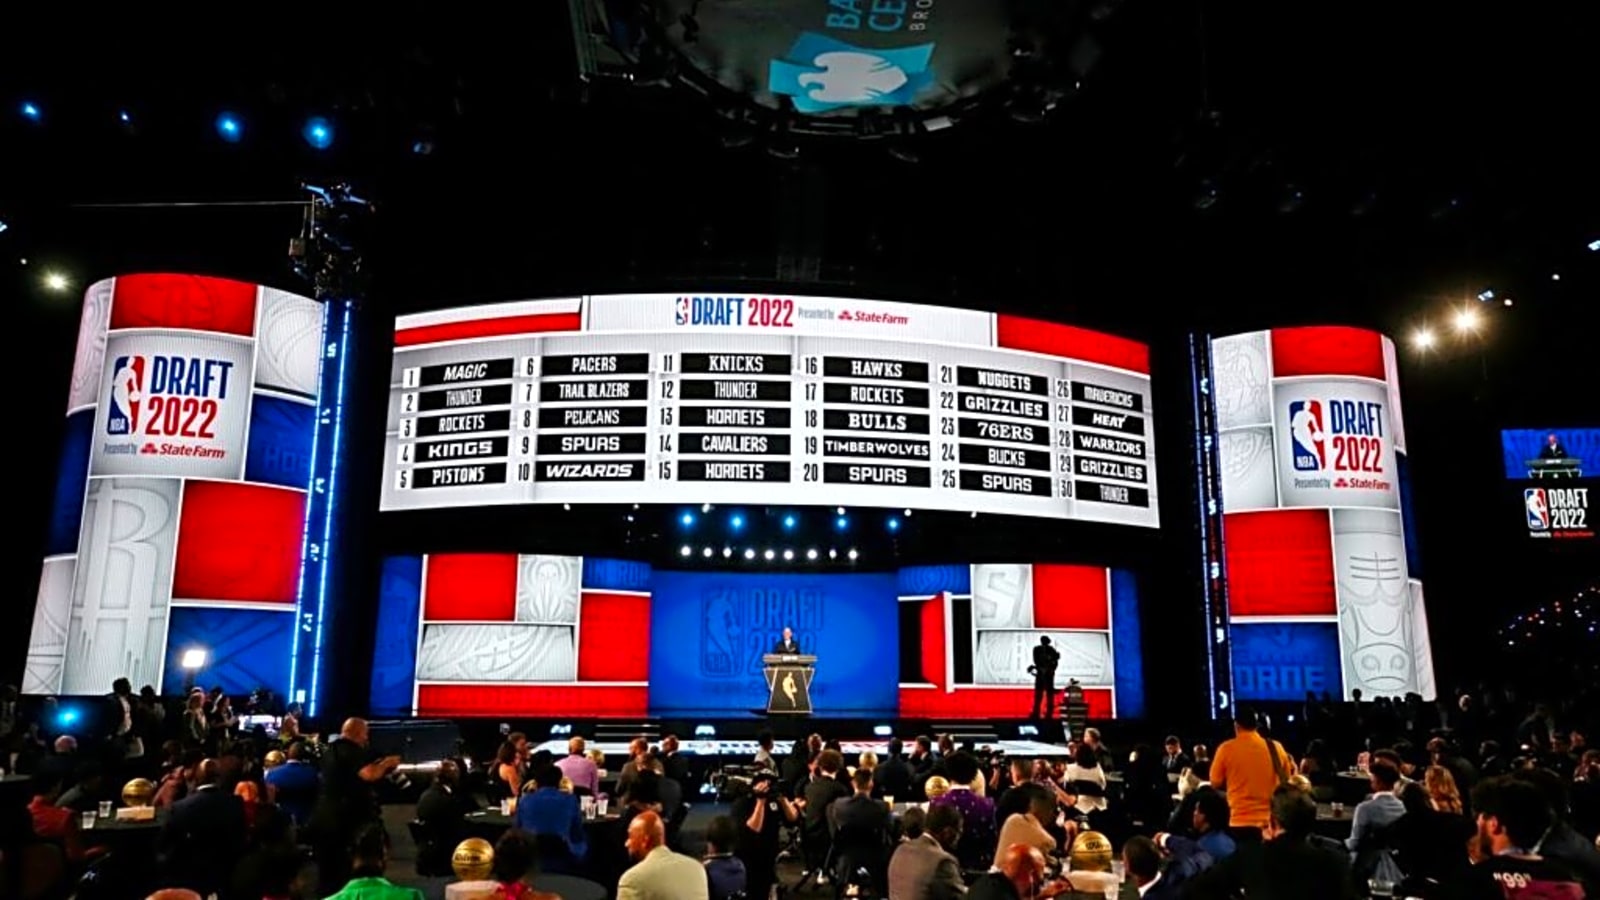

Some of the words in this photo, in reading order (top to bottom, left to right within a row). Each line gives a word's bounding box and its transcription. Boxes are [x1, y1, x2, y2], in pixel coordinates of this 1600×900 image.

[691, 297, 745, 326] DRAFT
[748, 298, 794, 328] 2022
[527, 359, 534, 375] 6
[572, 358, 616, 373] PACERS
[663, 355, 672, 371] 11
[709, 355, 763, 371] KNICKS
[805, 358, 817, 374] 16
[851, 360, 902, 378] HAWKS
[150, 355, 233, 399] DRAFT
[408, 370, 413, 386] 1
[443, 364, 488, 382] MAGIC
[940, 366, 952, 383] 21
[978, 371, 1031, 391] NUGGETS
[526, 384, 532, 400] 7
[559, 384, 585, 399] TRAIL
[587, 383, 629, 398] BLAZERS
[662, 381, 673, 398] 12
[714, 382, 758, 398] THUNDER
[805, 384, 816, 400] 17
[850, 387, 904, 404] ROCKETS
[1057, 380, 1069, 398] 26
[406, 394, 412, 411] 2
[446, 389, 482, 406] THUNDER
[940, 391, 954, 409] 22
[965, 395, 1043, 416] GRIZZLIES
[109, 418, 126, 432] NBA
[145, 396, 218, 439] 2022
[404, 420, 411, 436] 3
[439, 415, 485, 432] ROCKETS
[523, 410, 530, 427] 8
[564, 409, 620, 424] PELICANS
[661, 408, 672, 424] 13
[707, 409, 764, 425] HORNETS
[805, 411, 817, 427] 18
[848, 413, 907, 430] BULLS
[1058, 405, 1069, 422] 27
[1092, 413, 1127, 429] HEAT
[1329, 399, 1383, 438] DRAFT
[941, 418, 954, 435] 23
[978, 422, 1034, 441] 76ERS
[402, 446, 409, 462] 4
[428, 440, 493, 458] KINGS
[522, 437, 529, 454] 9
[561, 436, 620, 451] SPURS
[660, 435, 672, 451] 14
[702, 436, 768, 452] CAVALIERS
[805, 437, 817, 454] 19
[825, 440, 929, 456] TIMBERWOLVES
[1059, 429, 1071, 448] 28
[1080, 436, 1142, 456] WARRIORS
[942, 444, 955, 461] 24
[988, 449, 1025, 466] BUCKS
[1296, 455, 1315, 468] NBA
[1333, 436, 1383, 473] 2022
[400, 471, 407, 488] 5
[432, 466, 485, 484] PISTONS
[518, 463, 529, 480] 10
[546, 464, 633, 478] WIZARDS
[659, 462, 671, 479] 15
[705, 463, 764, 479] HORNETS
[804, 464, 818, 481] 20
[849, 467, 907, 483] SPURS
[1060, 455, 1071, 473] 29
[1080, 459, 1143, 480] GRIZZLIES
[942, 470, 955, 488] 25
[982, 475, 1032, 492] SPURS
[1061, 480, 1072, 498] 30
[1100, 484, 1128, 503] THUNDER
[1548, 488, 1588, 508] DRAFT
[1551, 508, 1587, 528] 2022
[750, 587, 823, 630] DRAFT
